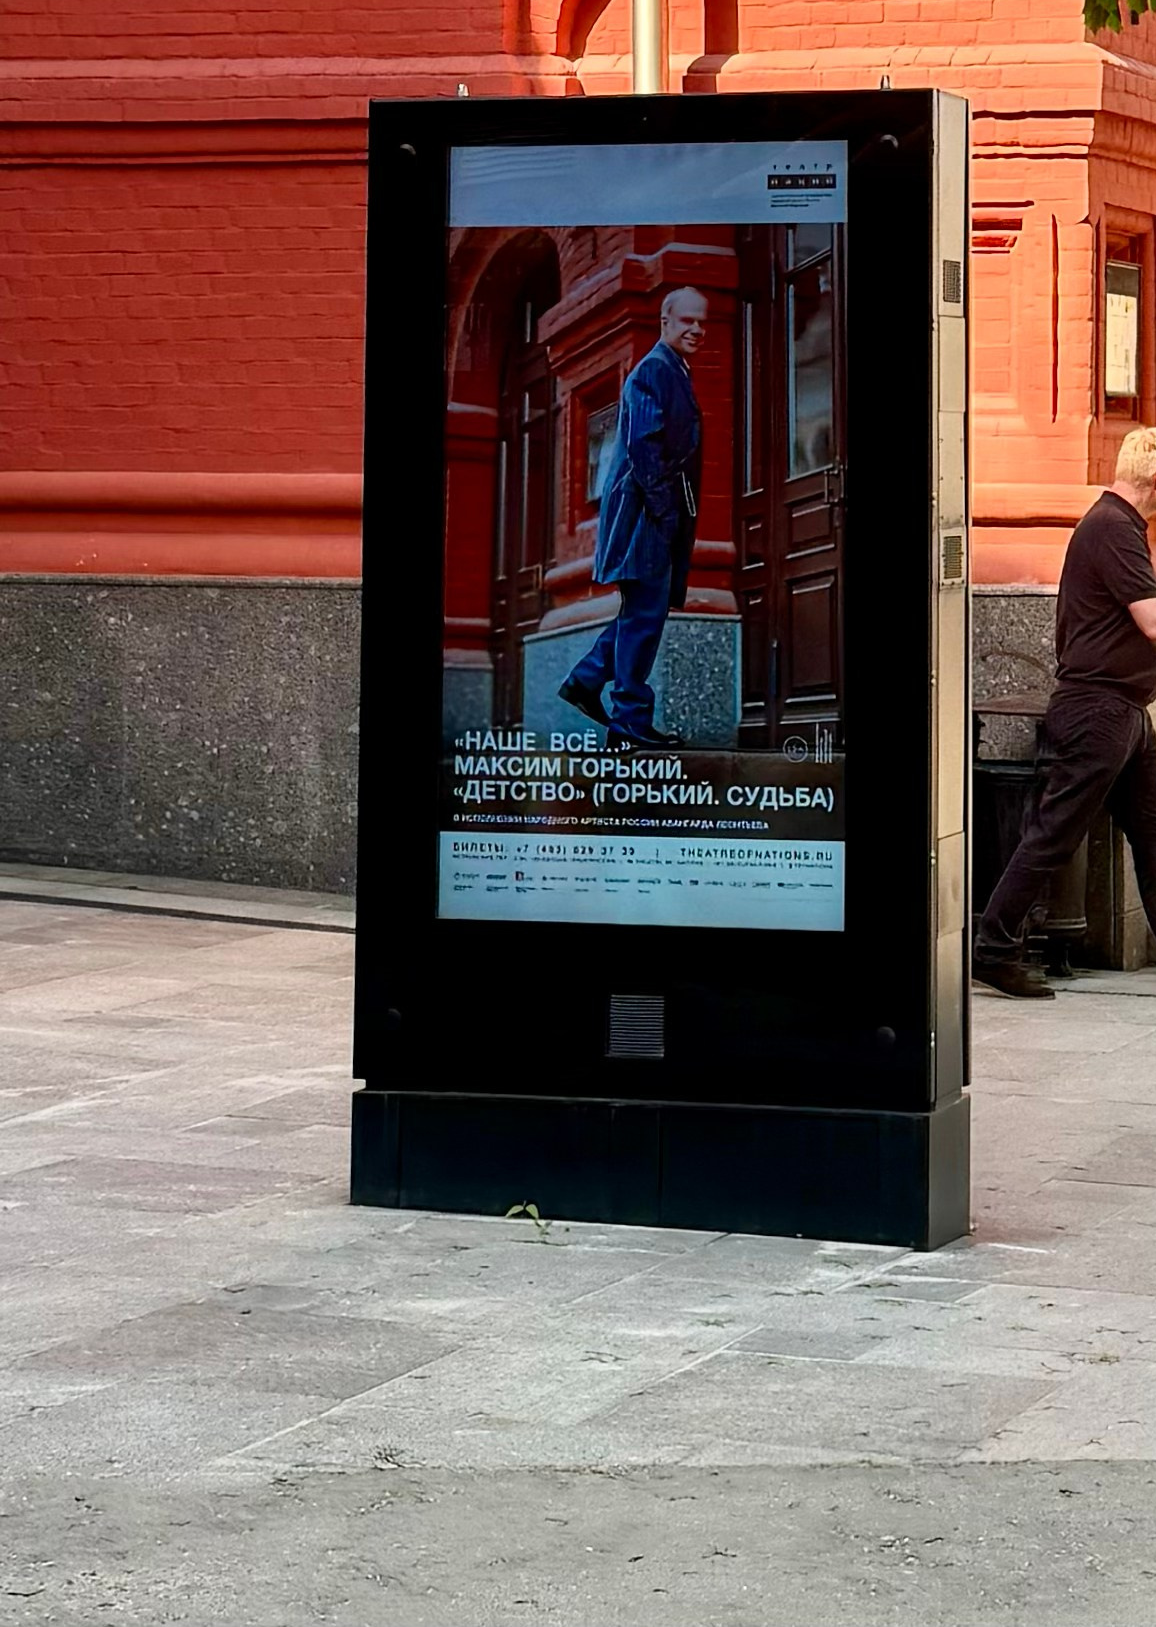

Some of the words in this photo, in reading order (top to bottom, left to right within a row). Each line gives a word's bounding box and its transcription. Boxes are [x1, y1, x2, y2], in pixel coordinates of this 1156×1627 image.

[455, 730, 536, 752] «НАШЕ
[550, 728, 631, 753] ВСЁ...»
[454, 755, 561, 776] МАКСИМ
[568, 755, 688, 779] ГОРЬКИЙ.
[453, 779, 586, 804] «ДЕТСТВО»
[592, 781, 720, 807] (ГОРЬКИЙ.
[726, 785, 835, 812] СУДЬБА)
